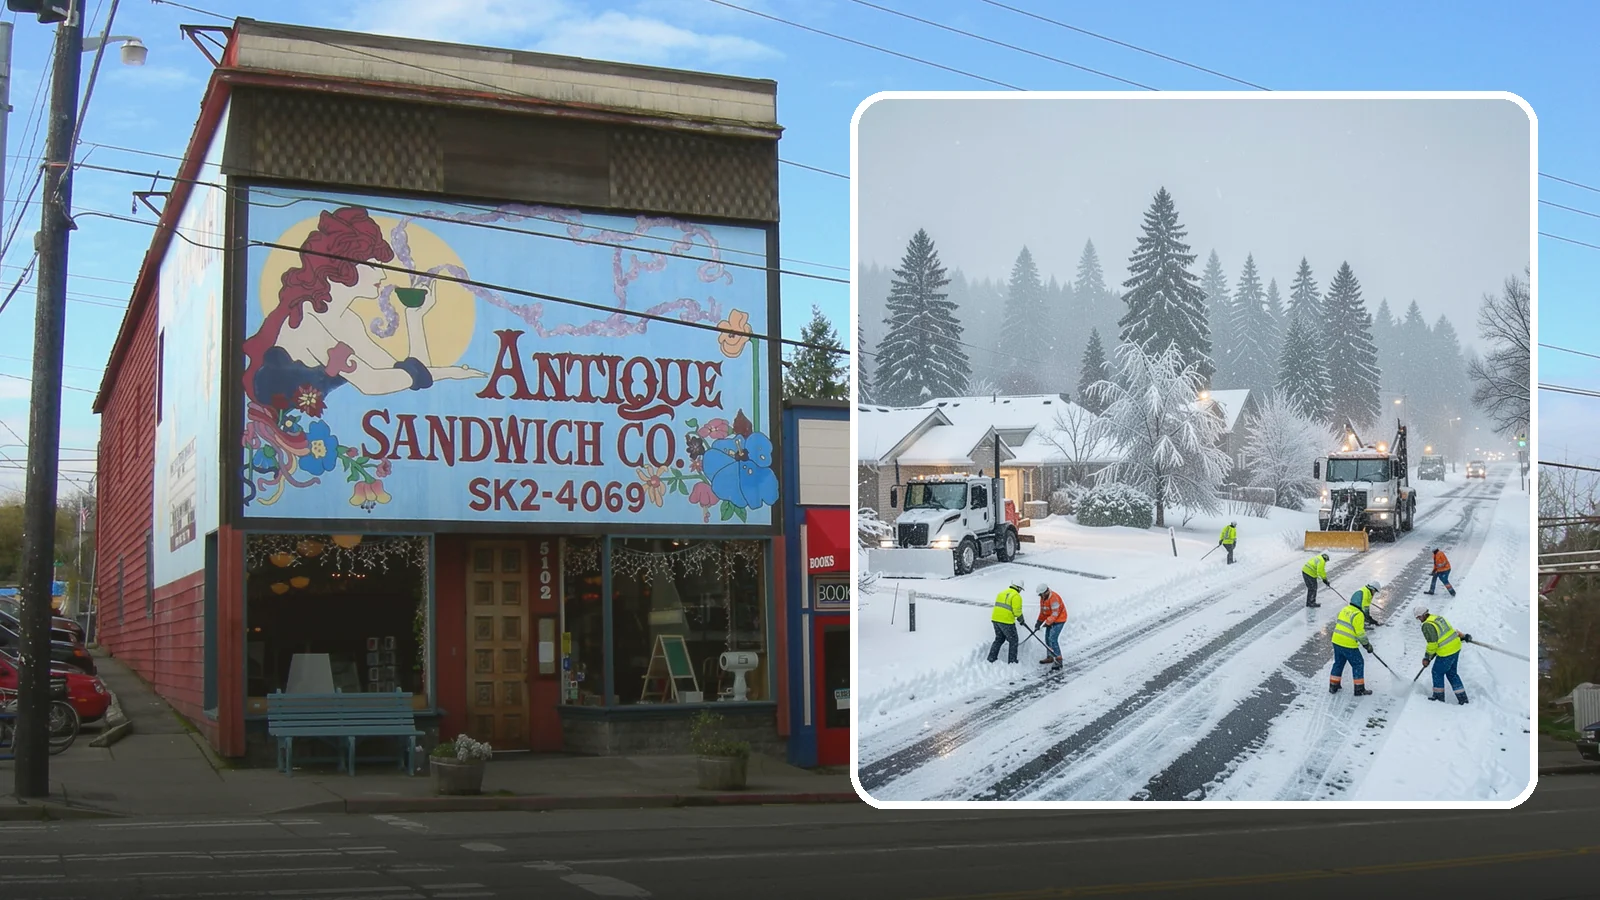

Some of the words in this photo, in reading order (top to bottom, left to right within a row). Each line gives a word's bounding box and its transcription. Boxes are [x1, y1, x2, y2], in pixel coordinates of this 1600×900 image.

[477, 329, 724, 420] ANTIQUE
[361, 408, 605, 468] SANDWICH
[616, 421, 686, 469] CO.
[468, 477, 646, 514] SK2-4069
[540, 541, 551, 600] 5102
[809, 555, 835, 569] BOOKS
